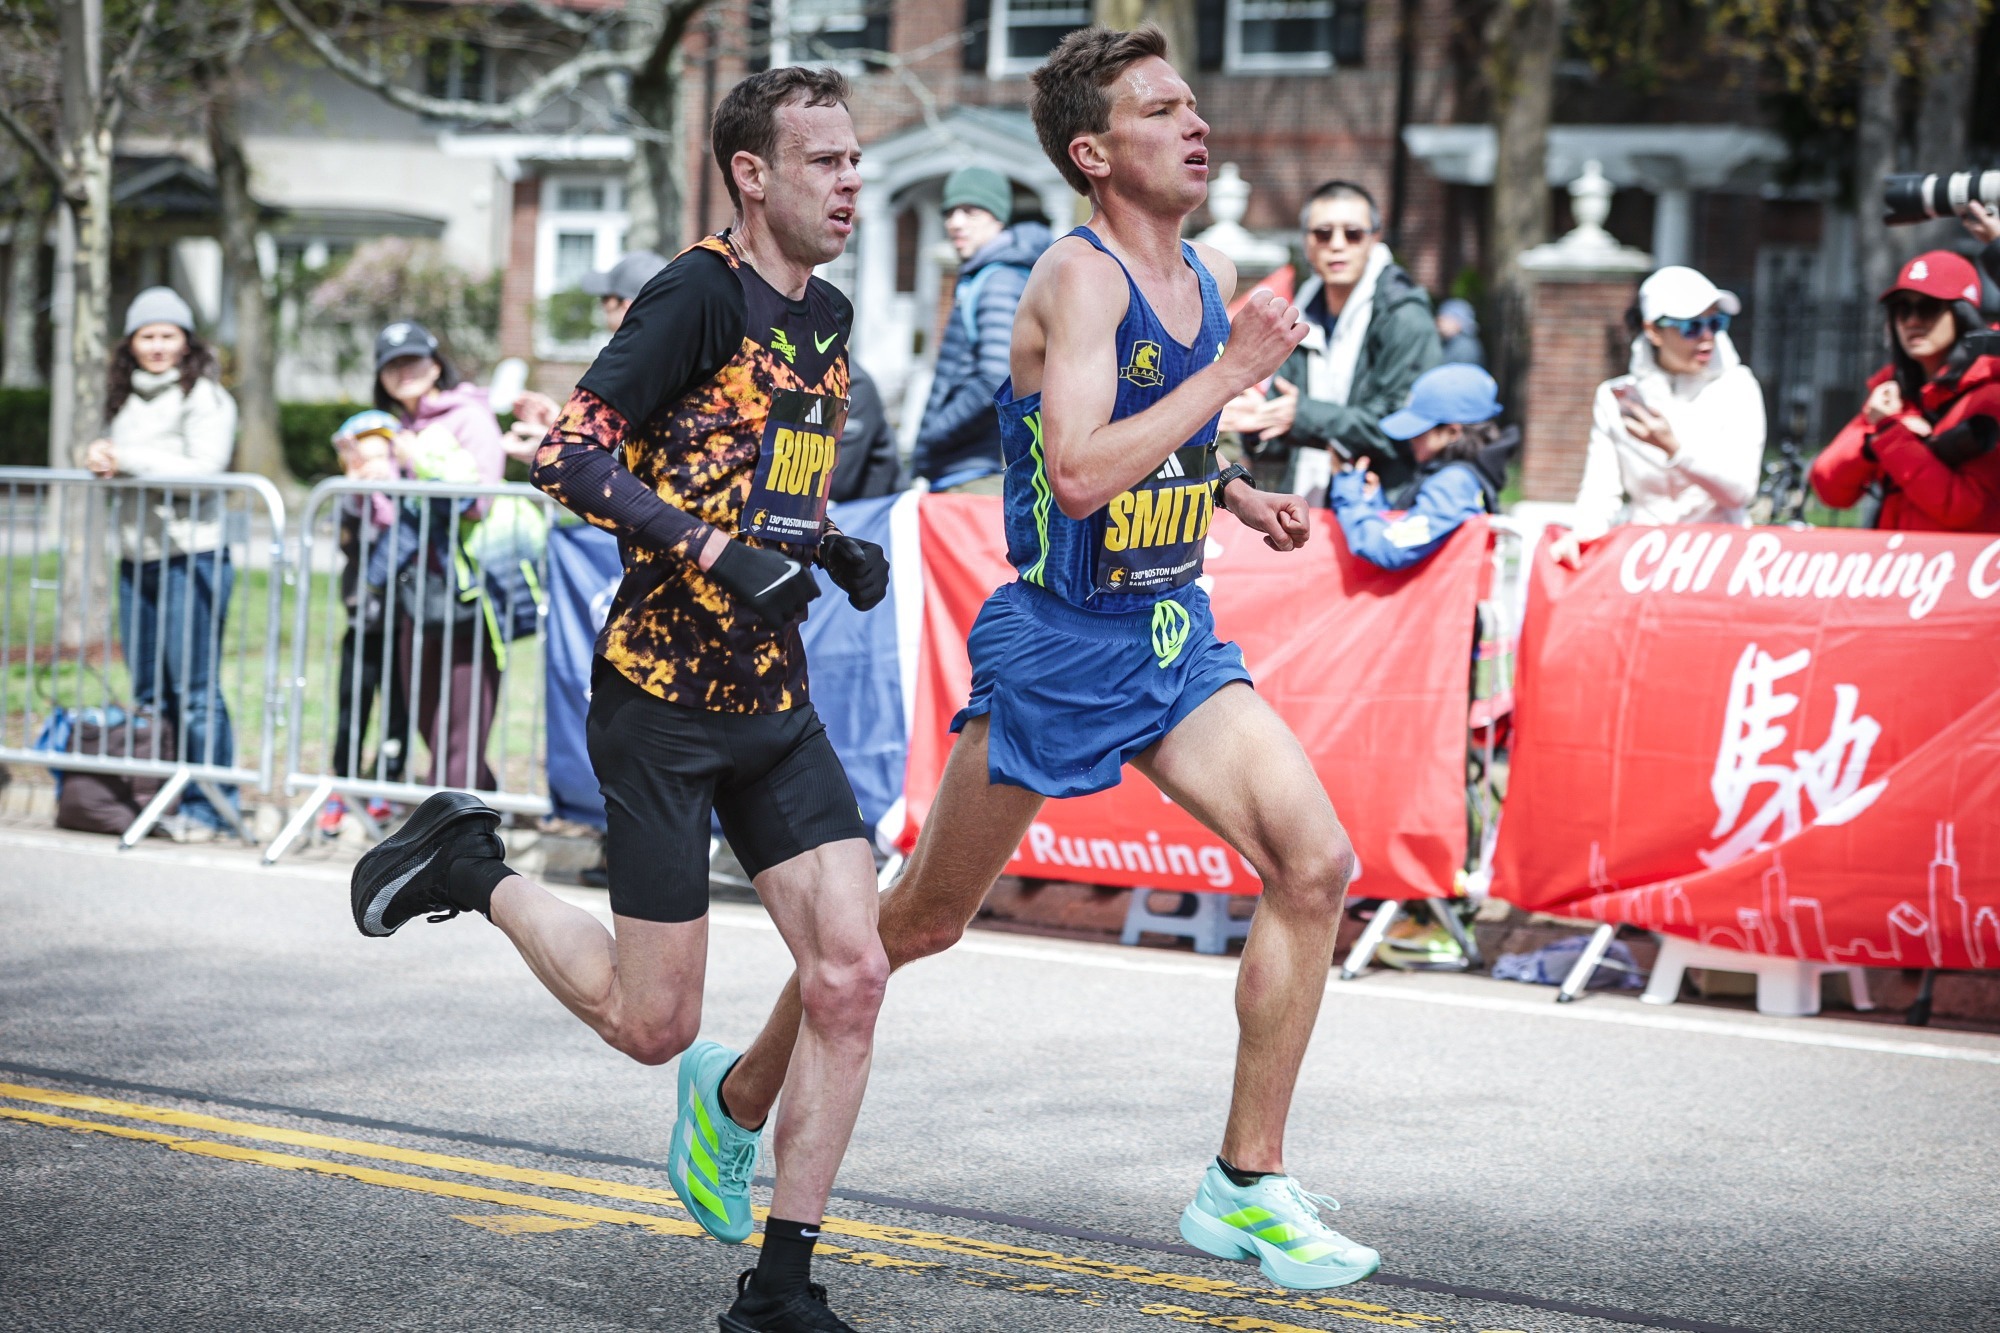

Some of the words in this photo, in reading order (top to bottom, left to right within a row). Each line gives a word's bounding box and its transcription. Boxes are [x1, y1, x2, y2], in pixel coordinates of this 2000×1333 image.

[771, 340, 796, 353] SWOOSH
[1132, 367, 1156, 379] B.A.A.
[765, 427, 835, 498] RUPP
[1104, 479, 1219, 552] SMITH
[783, 517, 802, 527] BOSTON
[767, 525, 781, 533] BANK
[1145, 567, 1170, 578] BOSTON
[1620, 529, 1731, 595] CHI
[1727, 533, 1956, 619] Running
[1152, 577, 1173, 585] AMERICA
[1029, 821, 1234, 887] Running
